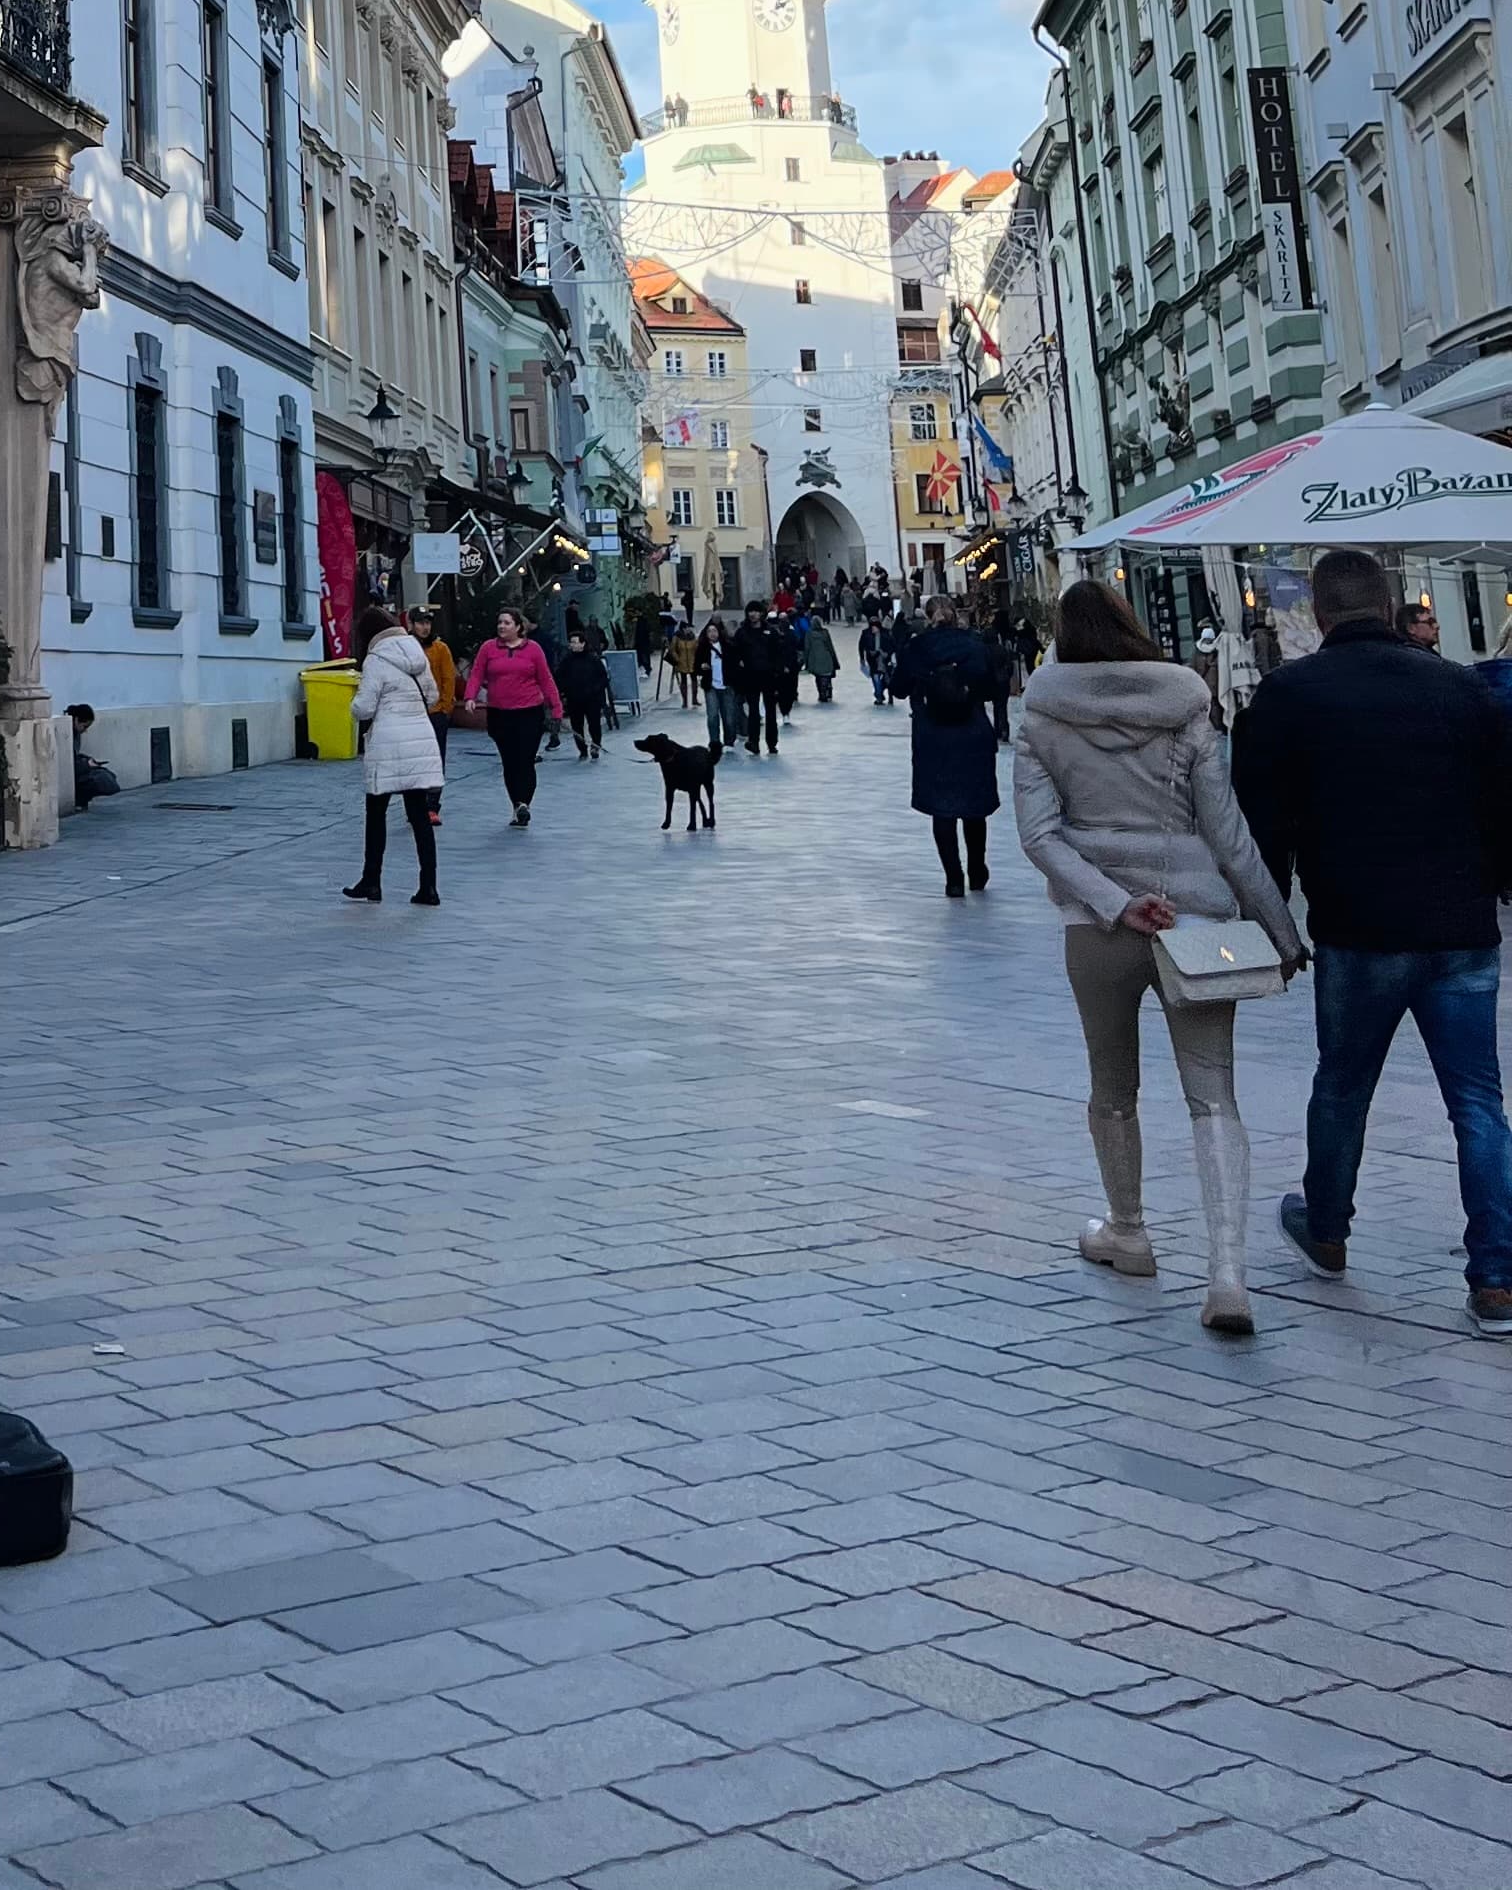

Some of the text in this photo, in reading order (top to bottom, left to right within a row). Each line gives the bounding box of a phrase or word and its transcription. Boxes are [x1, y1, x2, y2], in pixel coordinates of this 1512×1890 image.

[1257, 76, 1290, 198] HOTEL
[1272, 210, 1294, 304] SKARITZ
[1301, 481, 1405, 524] Zlatý
[1018, 534, 1033, 572] CIGAR
